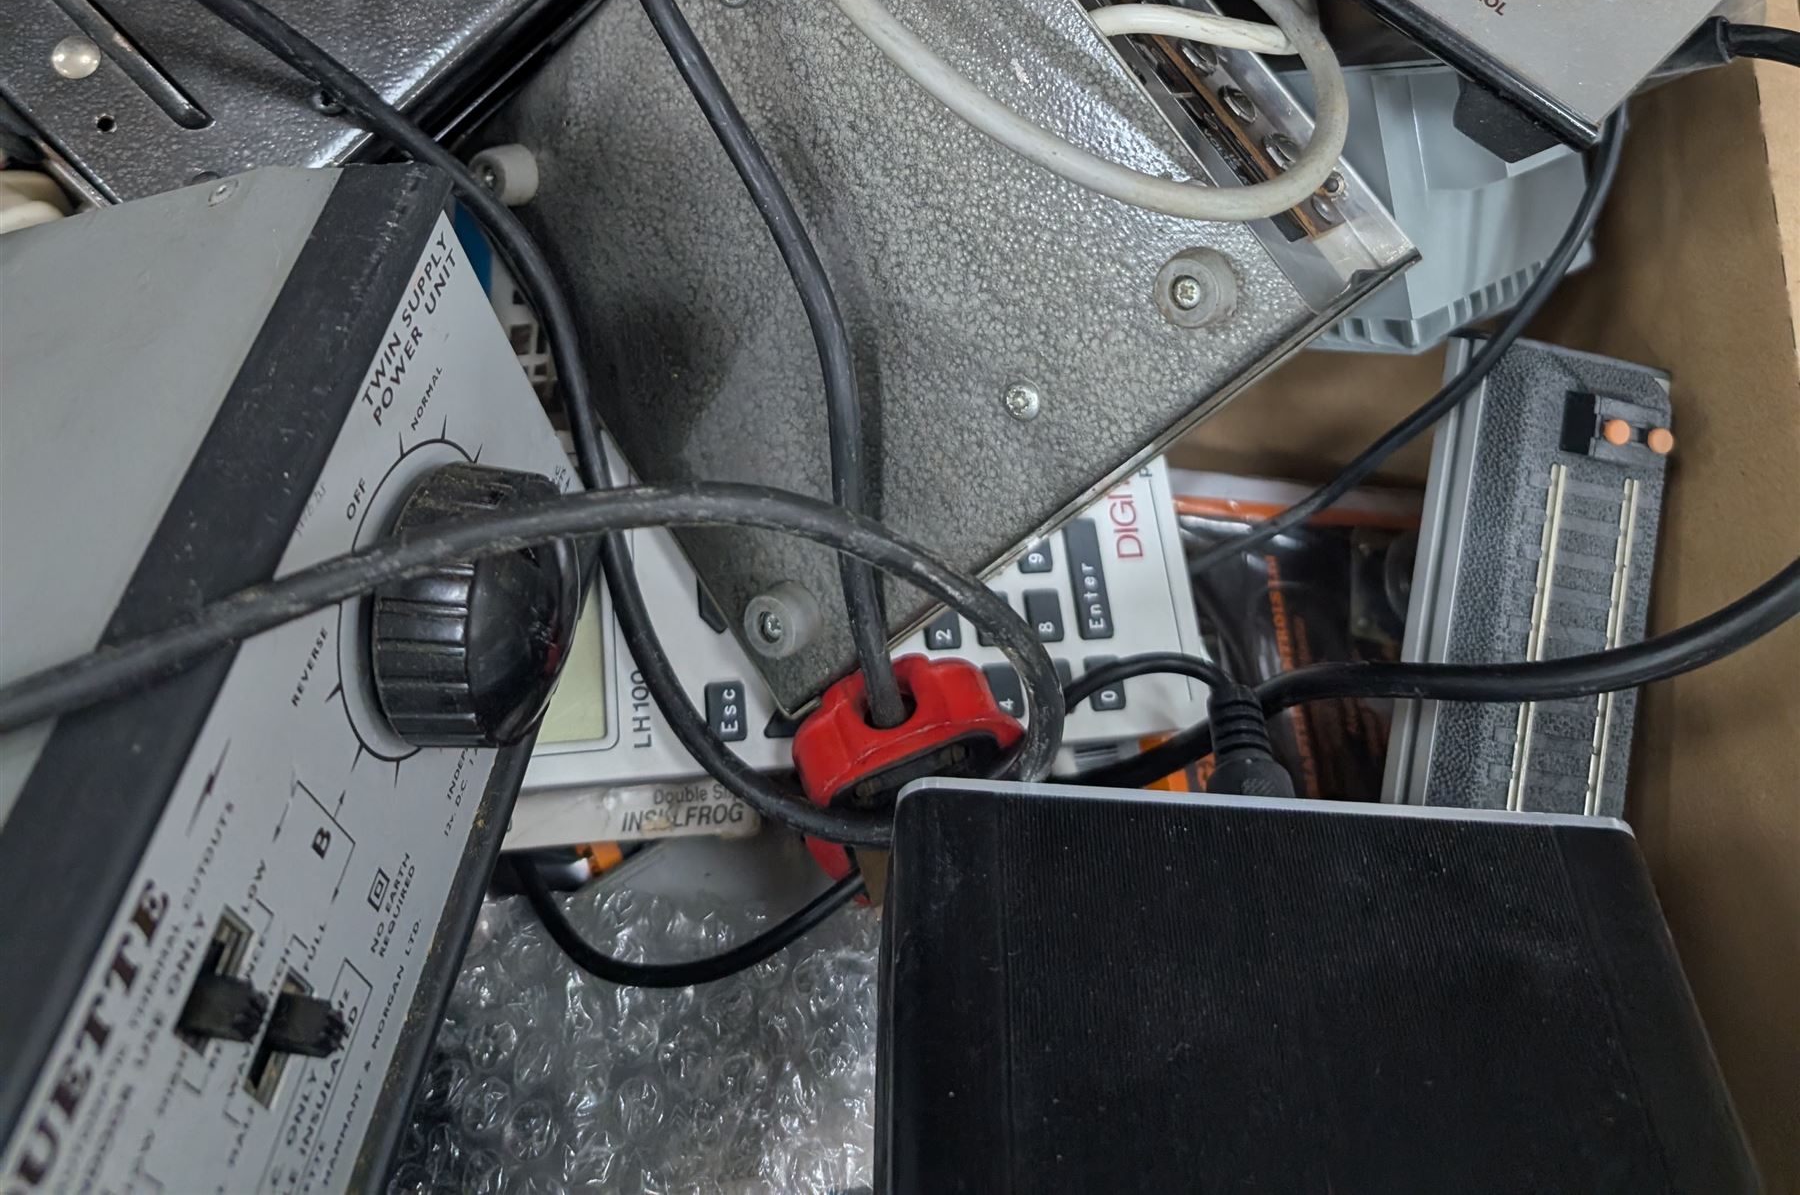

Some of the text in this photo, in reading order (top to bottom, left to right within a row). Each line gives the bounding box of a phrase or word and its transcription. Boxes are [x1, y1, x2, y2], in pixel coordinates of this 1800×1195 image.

[361, 230, 448, 406] TWIN SUPPLY
[372, 247, 458, 427] POWER UNIT
[410, 366, 443, 431] NORMAL
[346, 477, 367, 521] OFF
[1107, 480, 1143, 559] DIGI
[935, 628, 952, 641] 2
[1038, 621, 1054, 633] 8
[1082, 562, 1104, 630] Enter
[290, 627, 329, 708] REVERSE
[999, 697, 1015, 709] 4
[630, 669, 652, 749] LH100
[653, 787, 709, 805] Double
[312, 827, 331, 860] B
[241, 858, 267, 914] LOW
[370, 851, 411, 954] NO EARTH
[379, 864, 416, 958] REQUIRED
[166, 913, 205, 996] ONLY
[303, 921, 327, 973] FULL
[17, 879, 169, 1195] UETTE
[321, 1080, 363, 1186] HAMMANT
[371, 964, 405, 1050] MORGAN
[285, 1067, 318, 1147] ONLY
